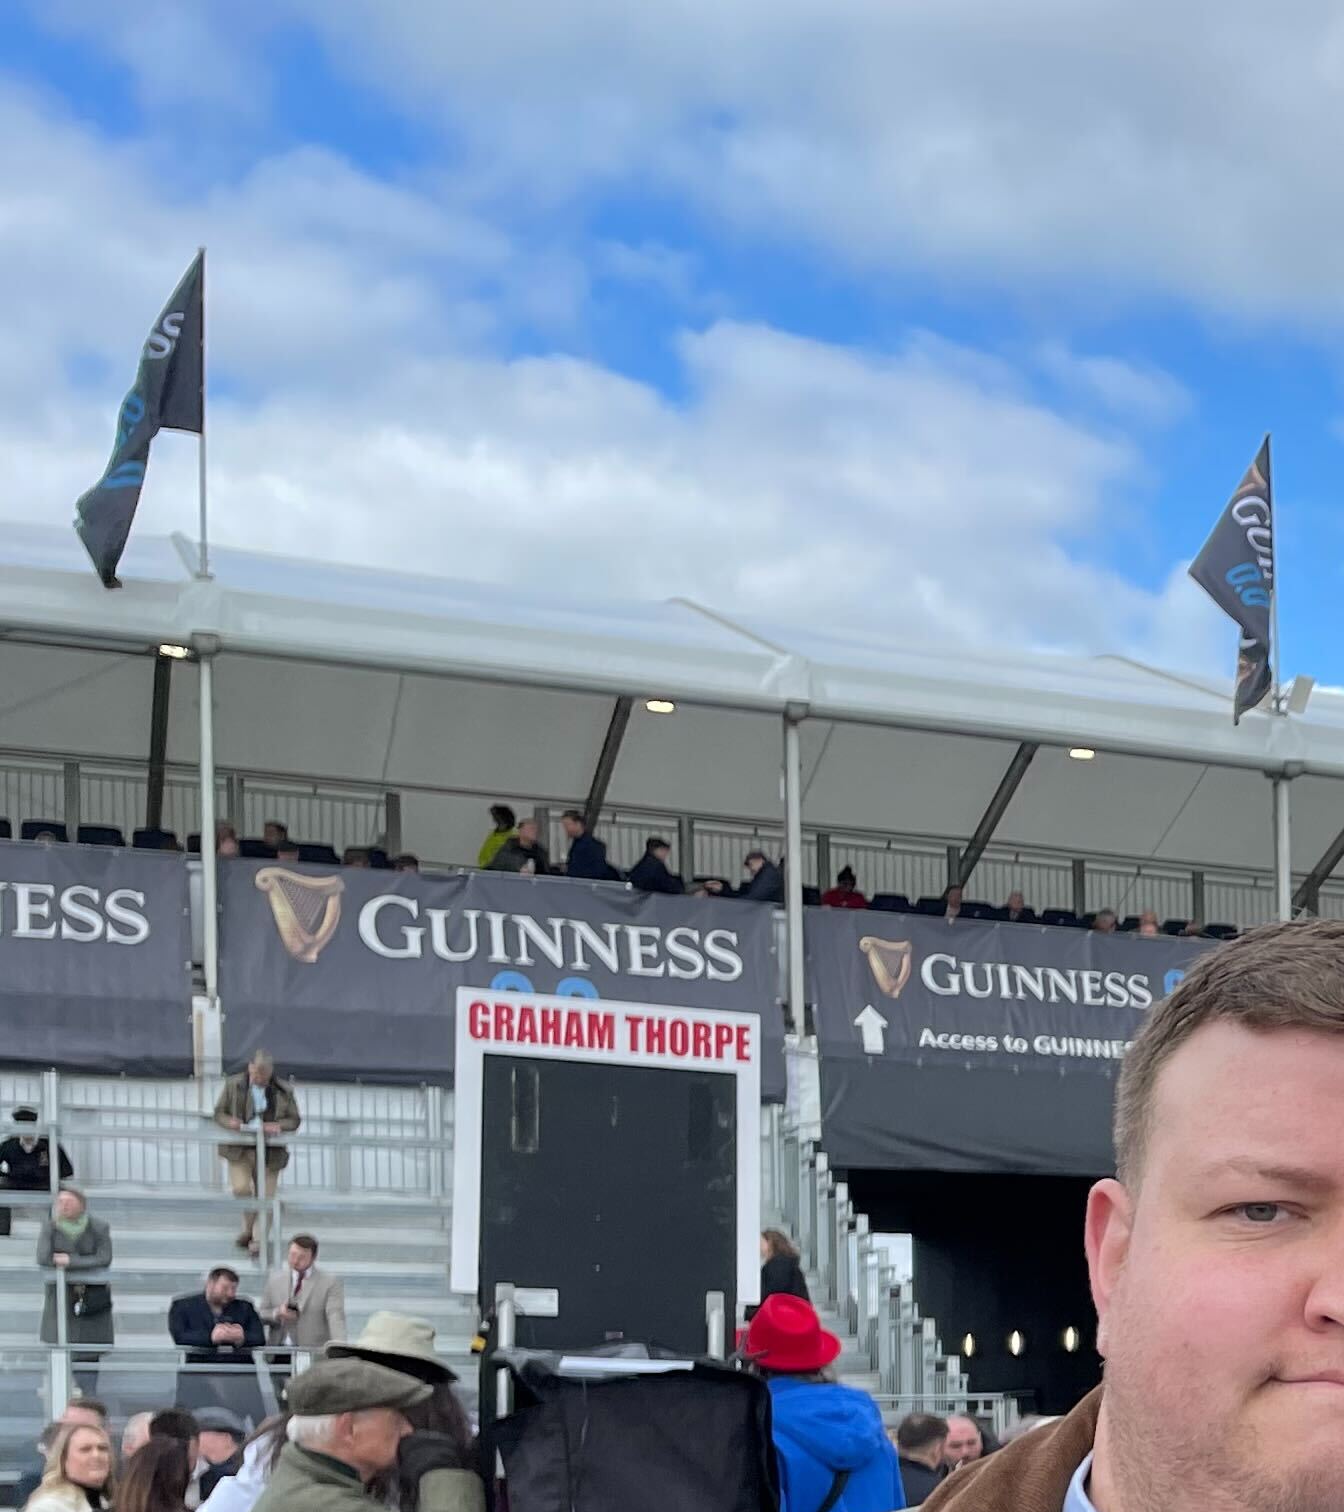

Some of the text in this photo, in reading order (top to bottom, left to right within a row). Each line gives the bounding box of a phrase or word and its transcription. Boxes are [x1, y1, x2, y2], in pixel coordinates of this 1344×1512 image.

[0, 881, 150, 945] ESS
[358, 894, 743, 982] GUINNESS
[921, 953, 1153, 1009] GUINNESS
[468, 1001, 752, 1062] GRAHAM THORPE
[918, 1028, 998, 1052] Access
[1003, 1034, 1029, 1054] to
